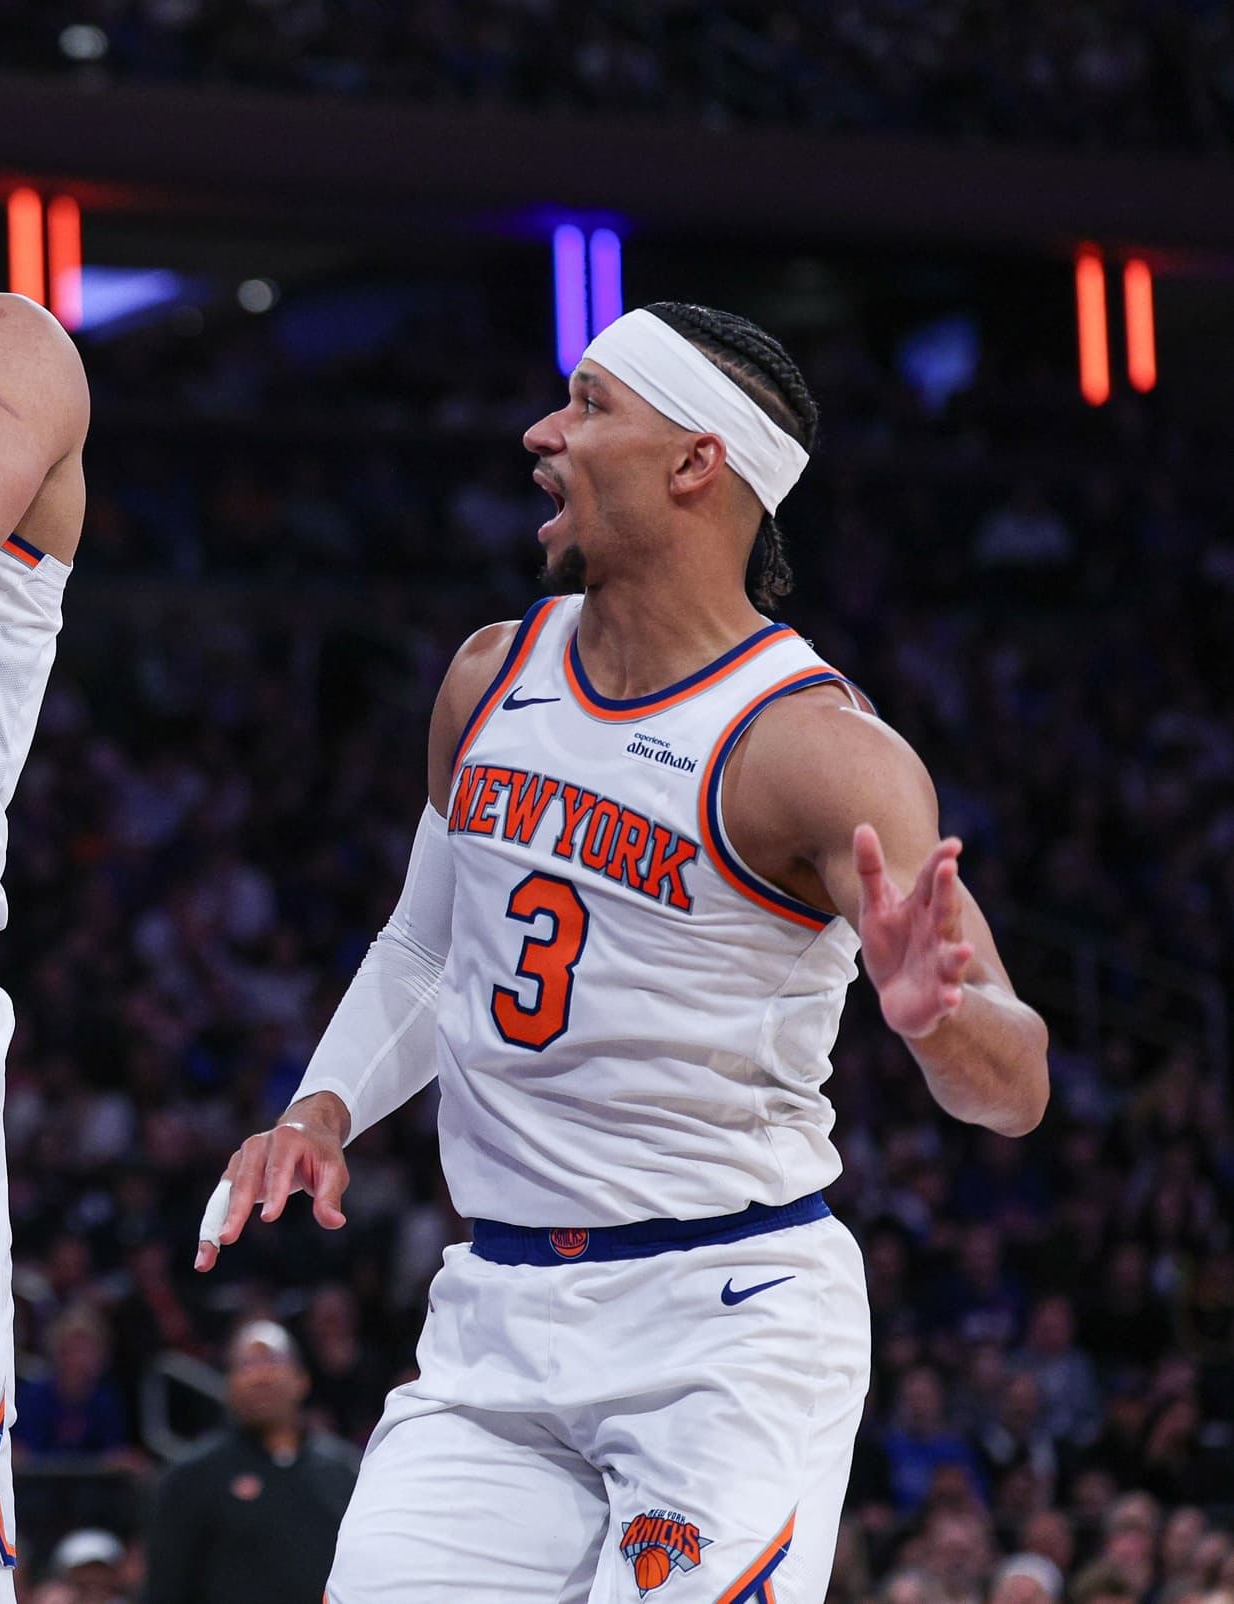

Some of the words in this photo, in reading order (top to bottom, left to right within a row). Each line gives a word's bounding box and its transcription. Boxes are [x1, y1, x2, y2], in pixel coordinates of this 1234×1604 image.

[627, 741, 654, 759] abu
[655, 749, 698, 773] dhabi
[634, 732, 670, 748] experience
[448, 764, 564, 849] NEW
[551, 784, 701, 915] YORK
[491, 870, 590, 1052] 3
[647, 1508, 667, 1518] NEW
[667, 1511, 686, 1523] YORK
[619, 1512, 701, 1565] KNICKS
